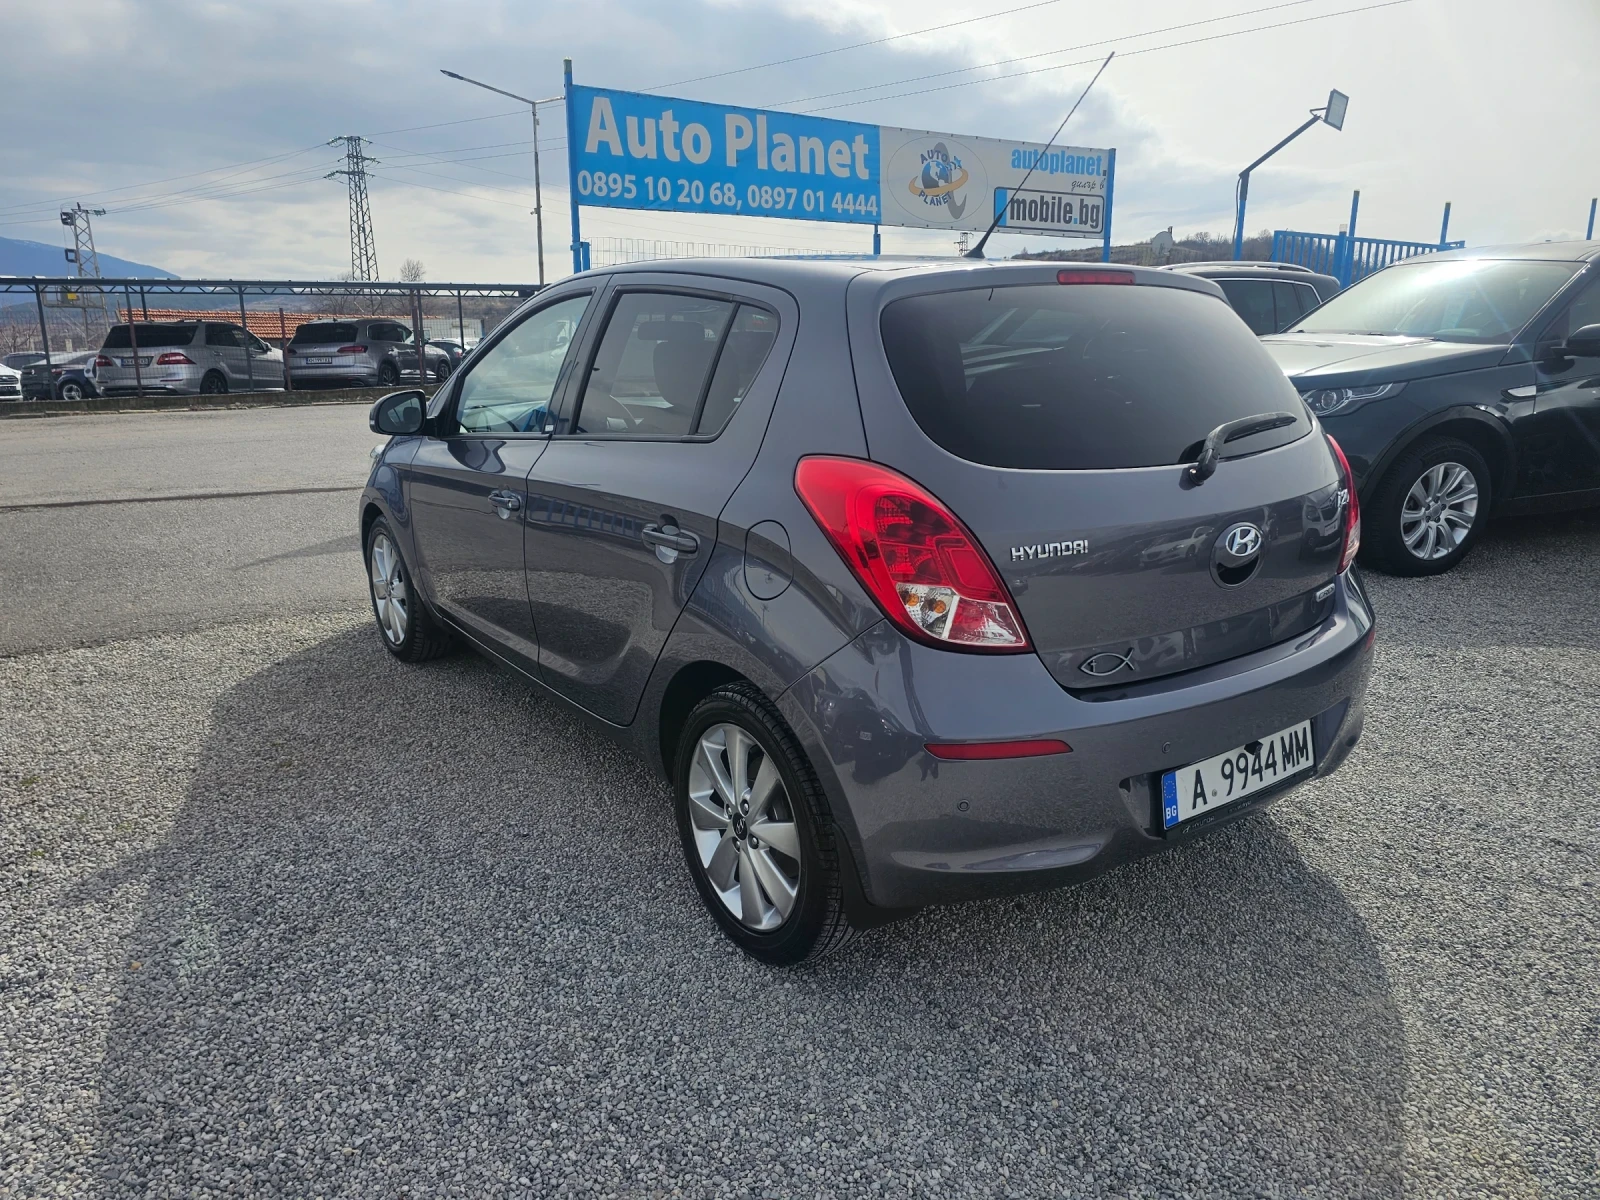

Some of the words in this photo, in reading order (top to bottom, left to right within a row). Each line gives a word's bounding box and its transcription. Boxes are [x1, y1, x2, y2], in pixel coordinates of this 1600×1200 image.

[584, 96, 712, 165] Auto
[725, 113, 869, 180] Planet
[920, 149, 948, 164] AUTO
[577, 170, 637, 198] 0895
[644, 176, 671, 202] 10
[677, 179, 704, 204] 20
[709, 182, 742, 210] 68,
[747, 184, 797, 210] 0897
[803, 189, 825, 213] 01
[831, 191, 878, 216] 4444
[919, 190, 951, 206] PLANET
[1009, 195, 1101, 229] mobile.bg
[1010, 539, 1089, 562] HYUNDAI
[1191, 769, 1208, 811] A
[1165, 805, 1177, 820] BG
